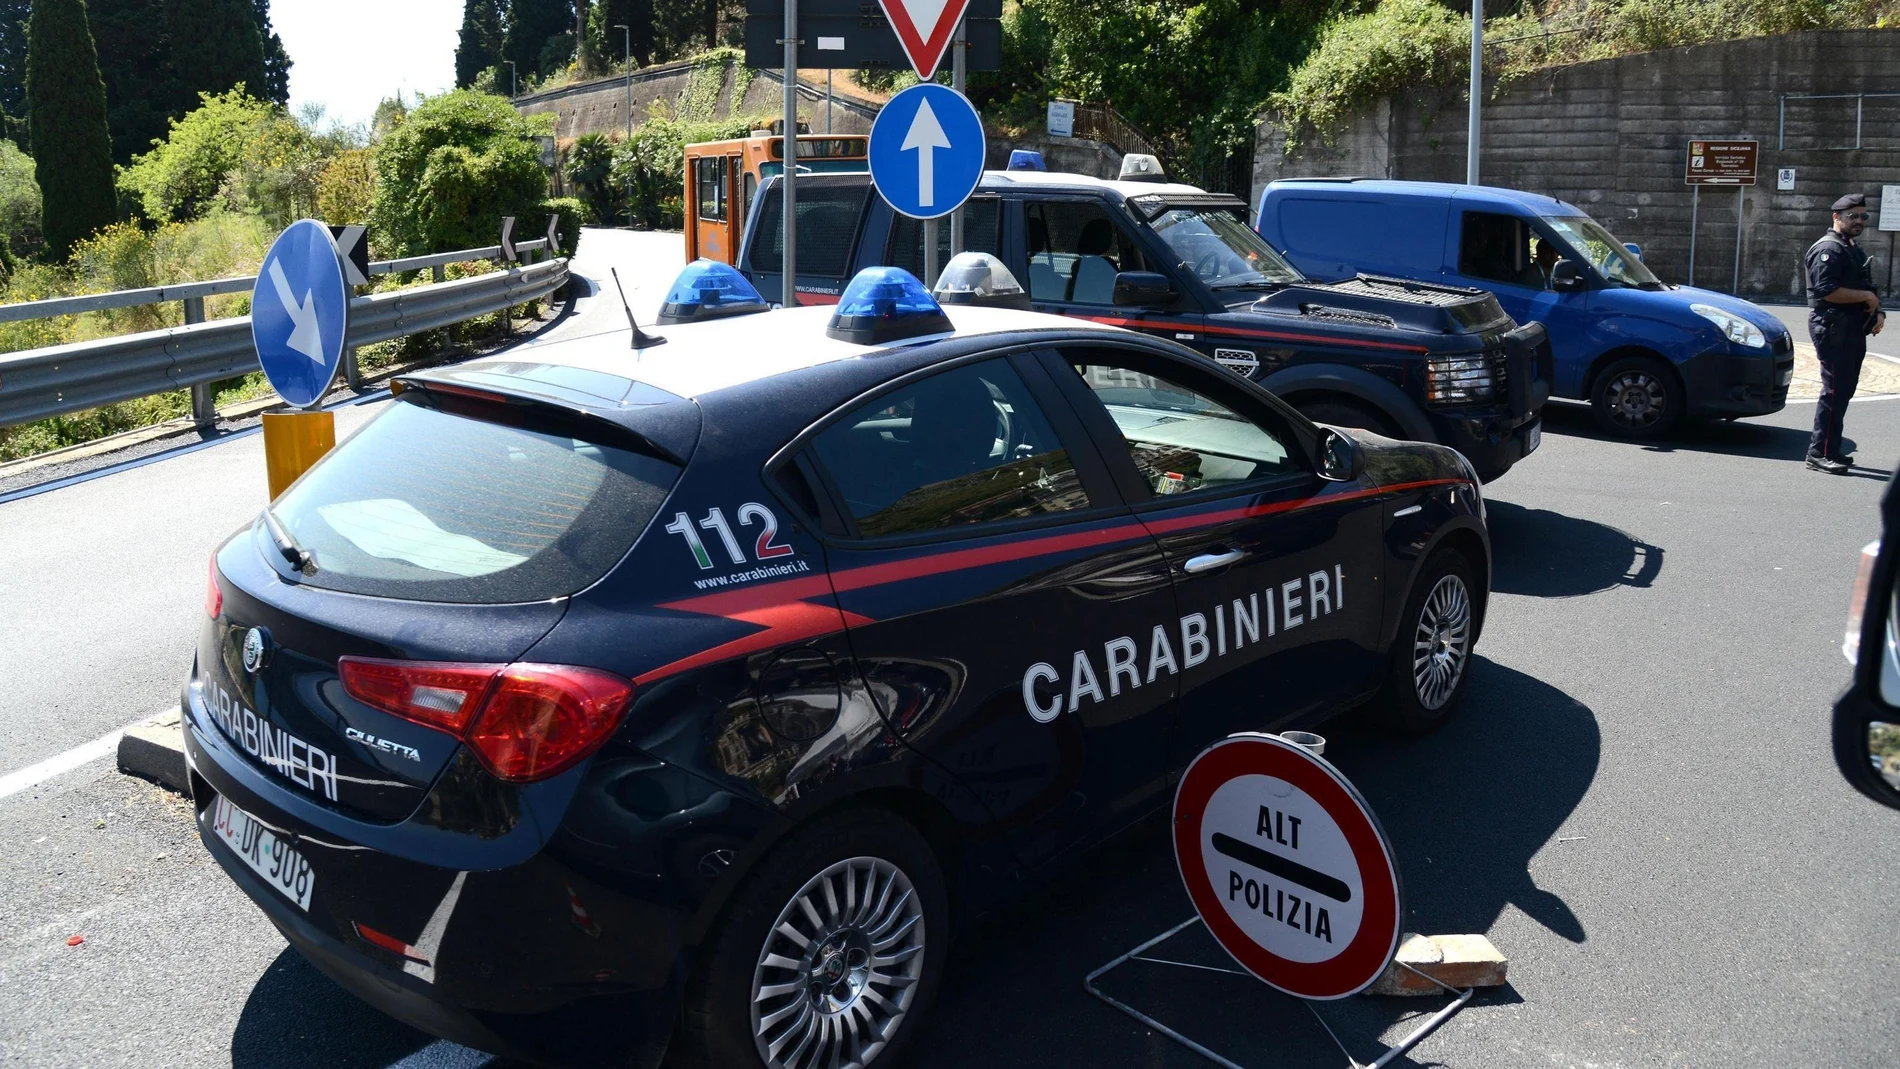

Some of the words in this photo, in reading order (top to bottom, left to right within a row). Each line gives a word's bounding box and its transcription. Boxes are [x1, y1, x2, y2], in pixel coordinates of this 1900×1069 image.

[665, 502, 795, 570] 112
[694, 560, 810, 589] www.carabinieri.it
[1022, 564, 1344, 724] CARABINIERI
[203, 671, 338, 802] CARABINIERI
[346, 727, 421, 762] GIULIETTA
[1256, 804, 1302, 850] ALT
[270, 837, 311, 898] 908
[1229, 869, 1332, 944] POLIZIA
